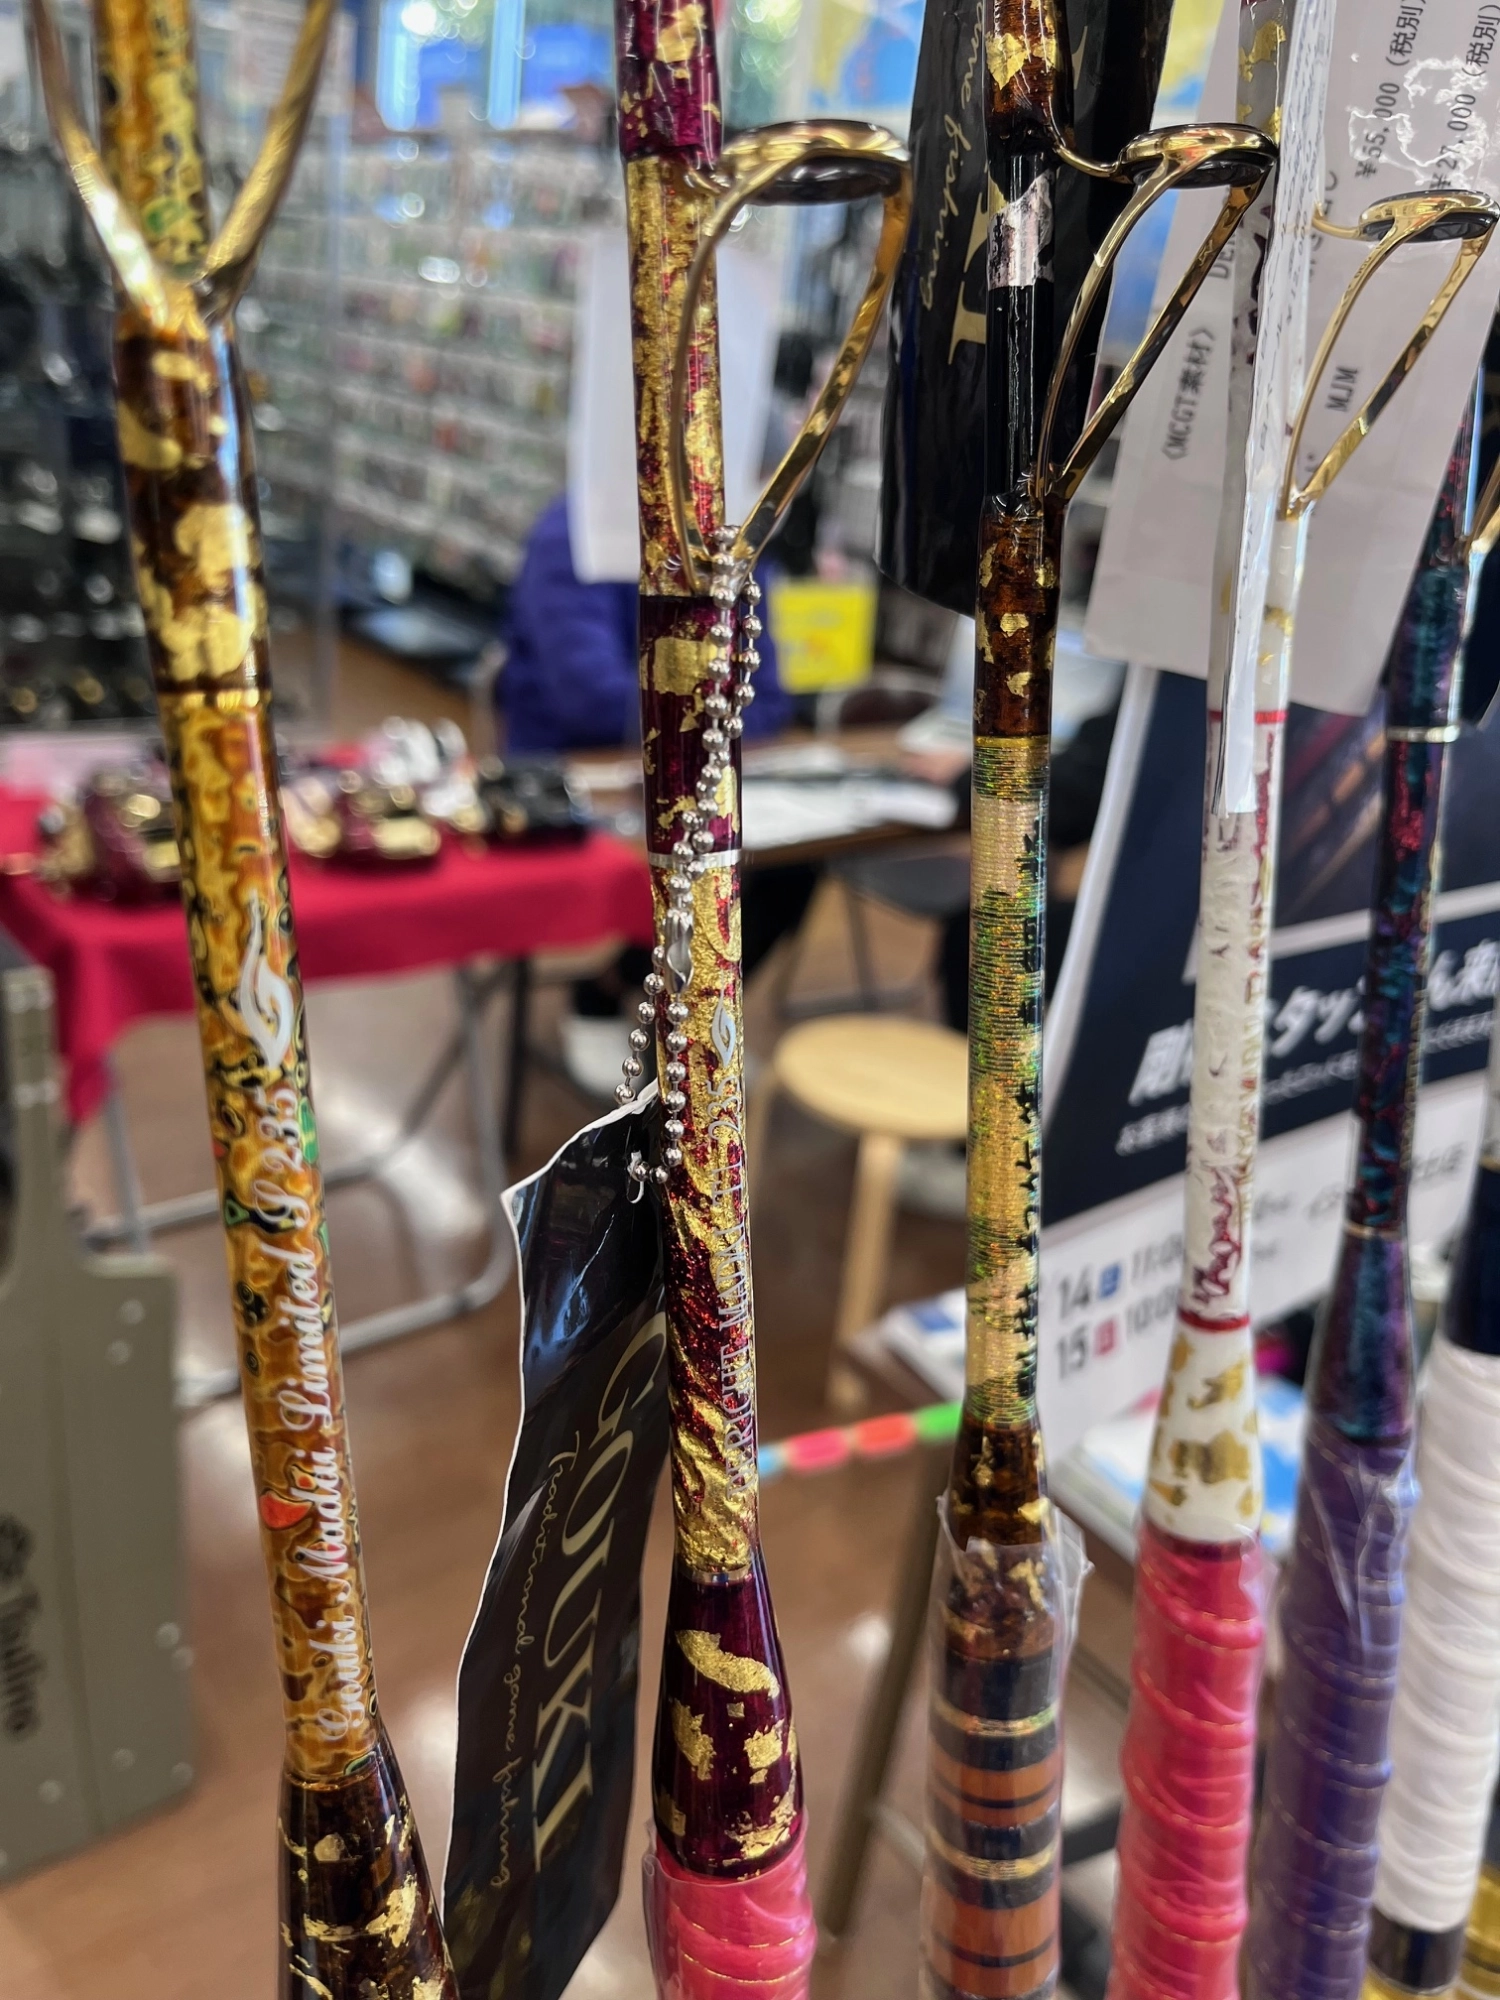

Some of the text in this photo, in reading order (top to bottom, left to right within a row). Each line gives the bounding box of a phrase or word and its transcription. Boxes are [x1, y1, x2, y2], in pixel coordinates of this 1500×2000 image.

[919, 114, 972, 310] fishing
[1324, 365, 1359, 413] MJM
[255, 1086, 305, 1173] 235
[707, 1074, 742, 1141] 235
[260, 1241, 334, 1431] Limited
[713, 1217, 750, 1332] MADAI
[290, 1446, 351, 1602] Madai
[535, 1310, 668, 1873] GOUKI
[309, 1614, 365, 1742] Gouki
[490, 1429, 581, 1887] Traditional game fishing
